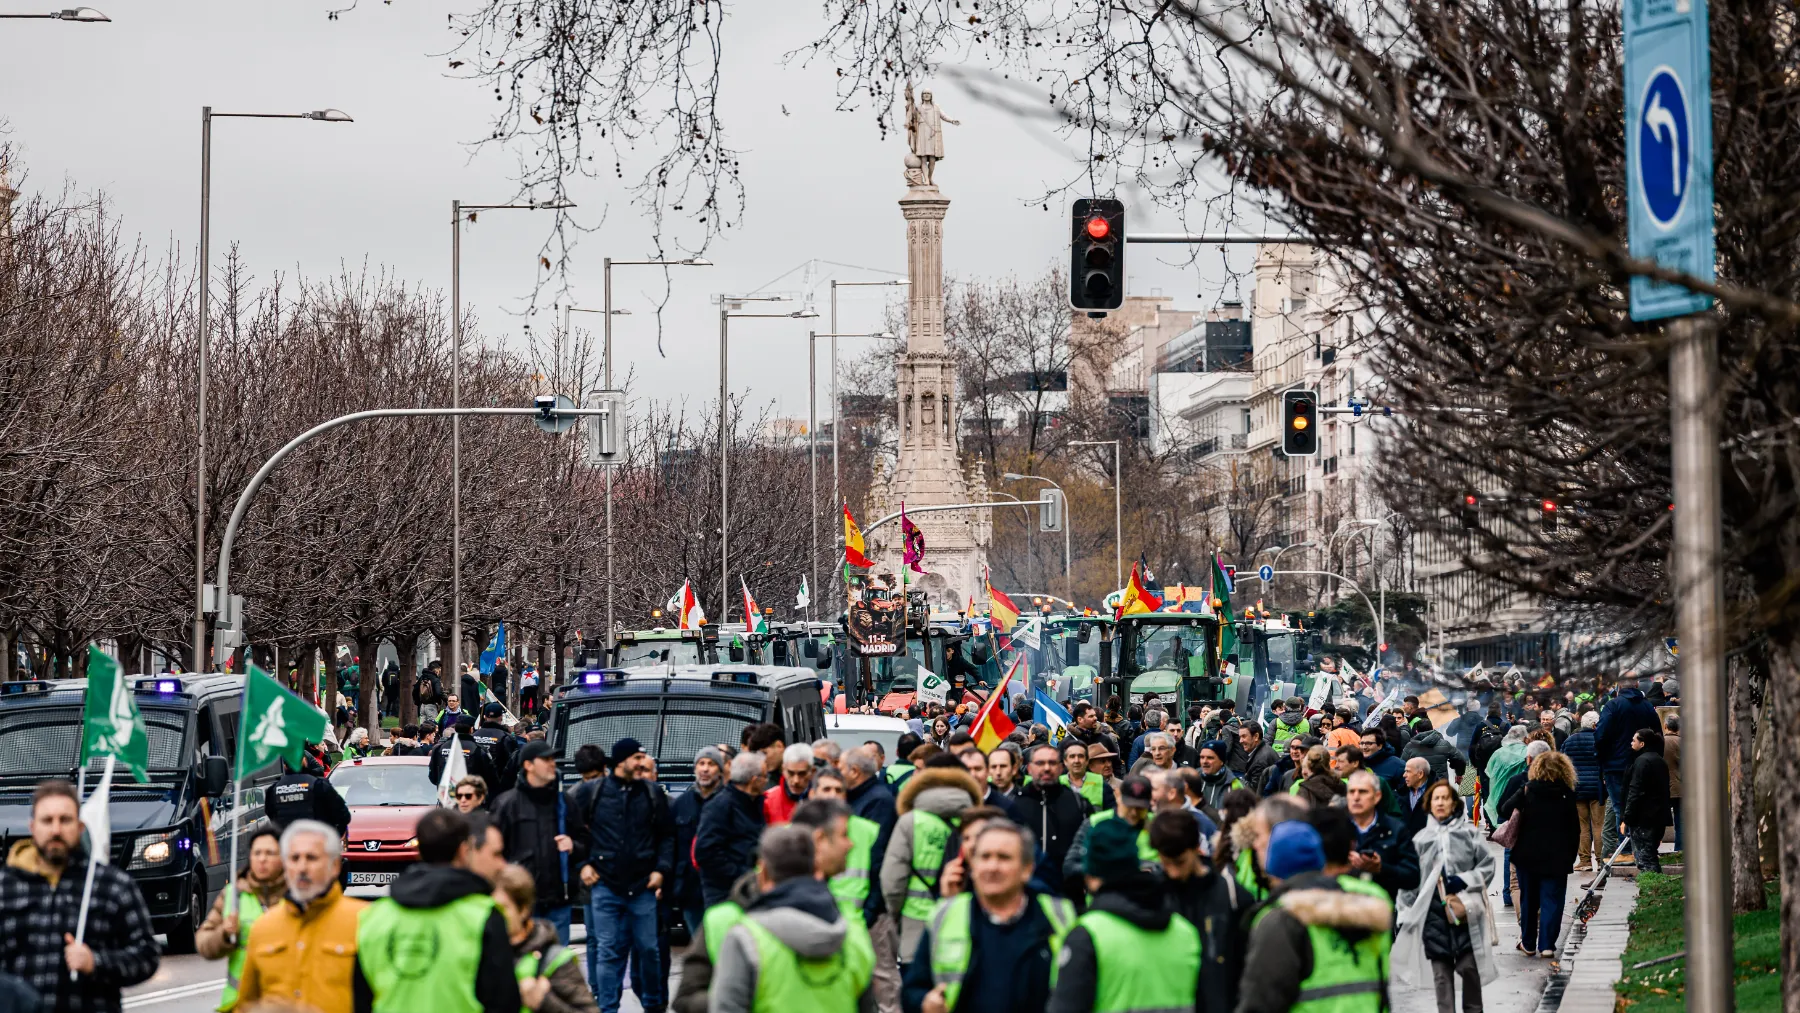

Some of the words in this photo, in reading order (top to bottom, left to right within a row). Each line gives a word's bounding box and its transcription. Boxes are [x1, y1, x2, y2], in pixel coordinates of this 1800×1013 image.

[868, 634, 887, 643] 11-F
[860, 643, 897, 653] MADRID
[353, 874, 377, 882] 2567
